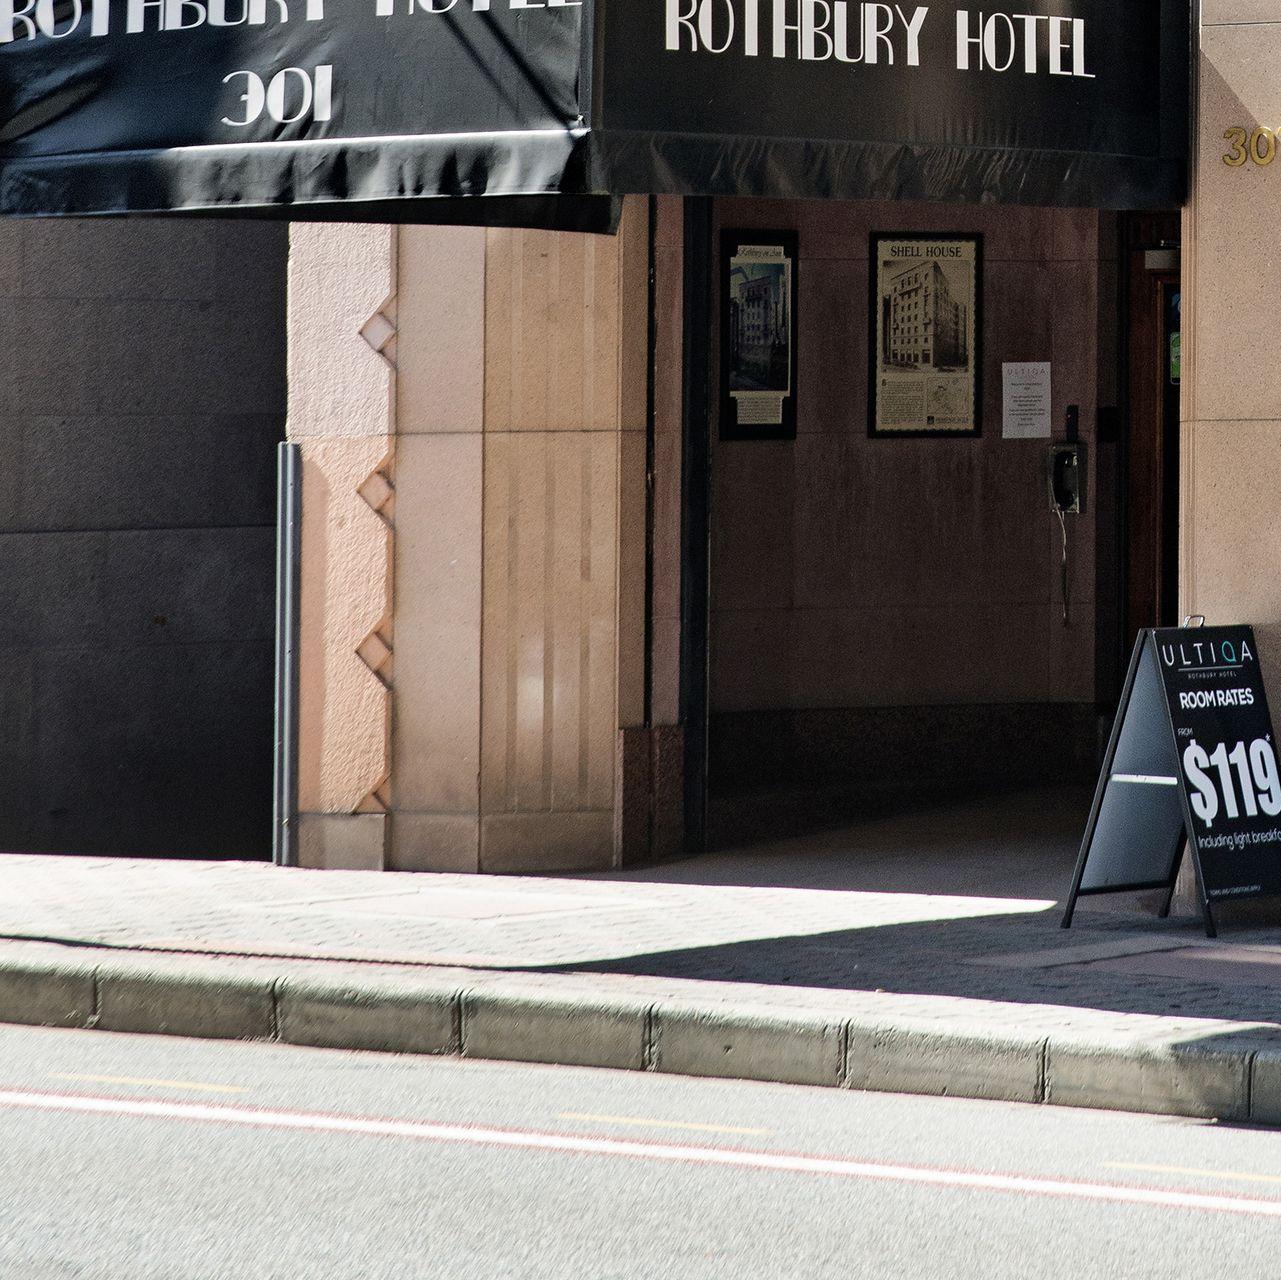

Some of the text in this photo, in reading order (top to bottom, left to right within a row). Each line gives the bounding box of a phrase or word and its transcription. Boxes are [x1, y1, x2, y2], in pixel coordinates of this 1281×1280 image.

[955, 9, 1097, 79] HOTEL
[221, 63, 334, 127] 301
[890, 246, 963, 258] SHELL HOUSE
[1162, 640, 1253, 666] ULTIQA
[1179, 687, 1255, 710] ROOM RATES
